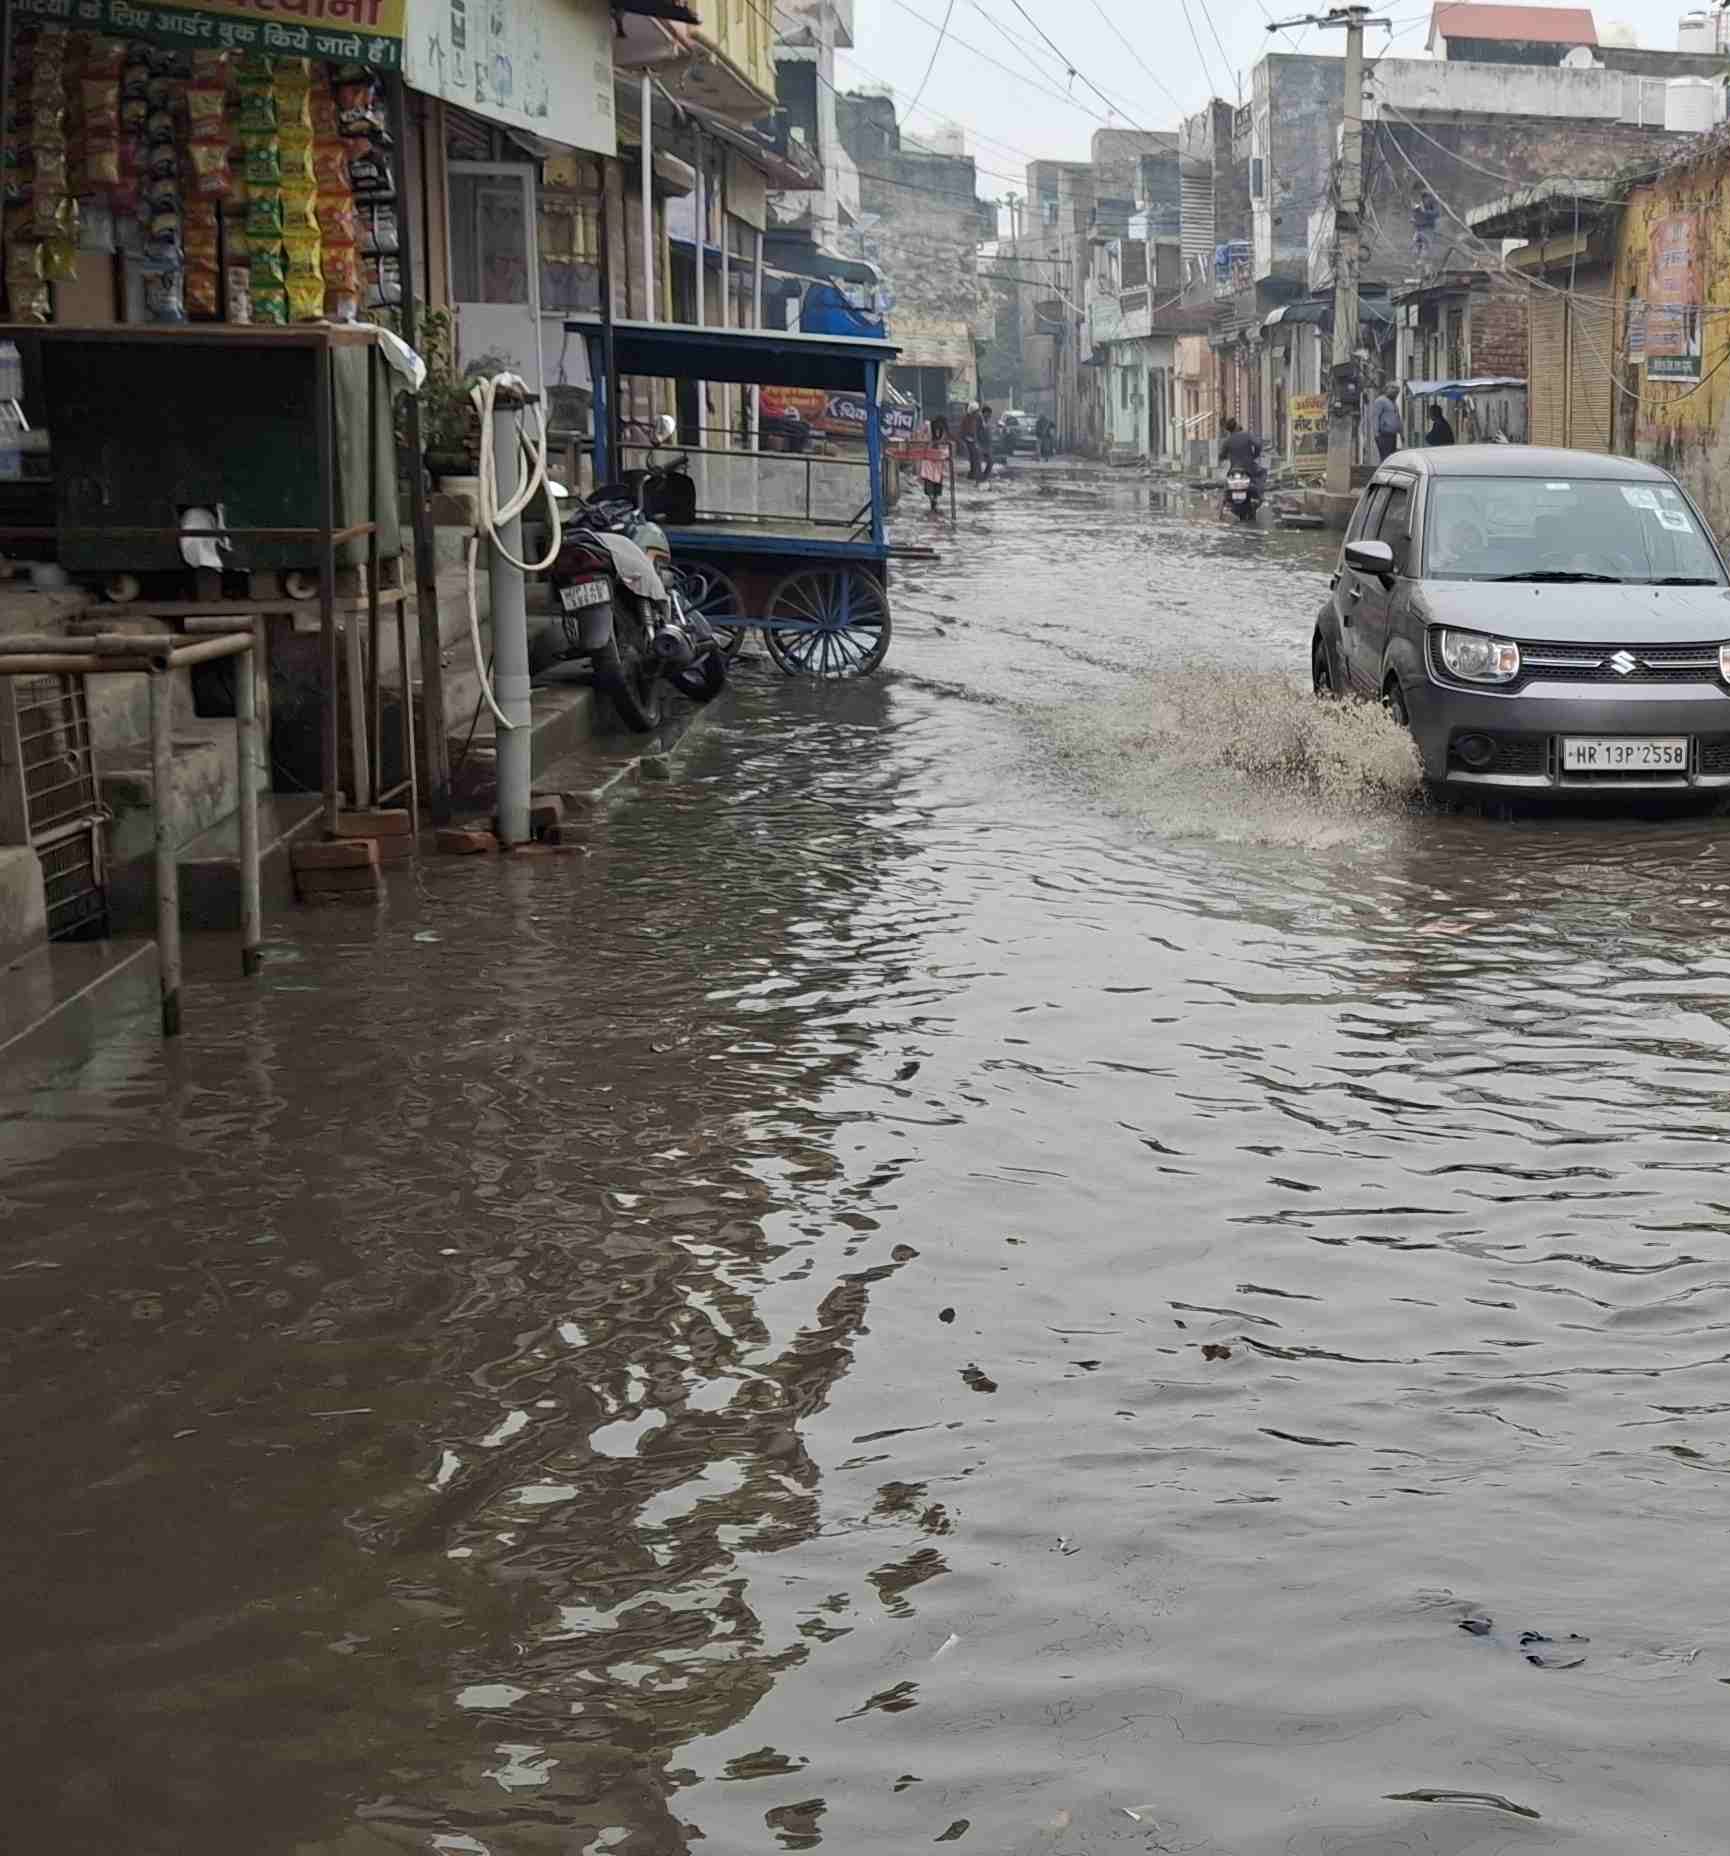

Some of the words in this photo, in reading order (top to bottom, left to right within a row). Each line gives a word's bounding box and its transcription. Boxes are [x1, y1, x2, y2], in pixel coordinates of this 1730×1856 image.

[263, 22, 310, 50] किये
[314, 32, 362, 57] जाते
[1576, 746, 1598, 765] HR
[1606, 746, 1634, 765] 13P
[1641, 746, 1683, 764] 2558
